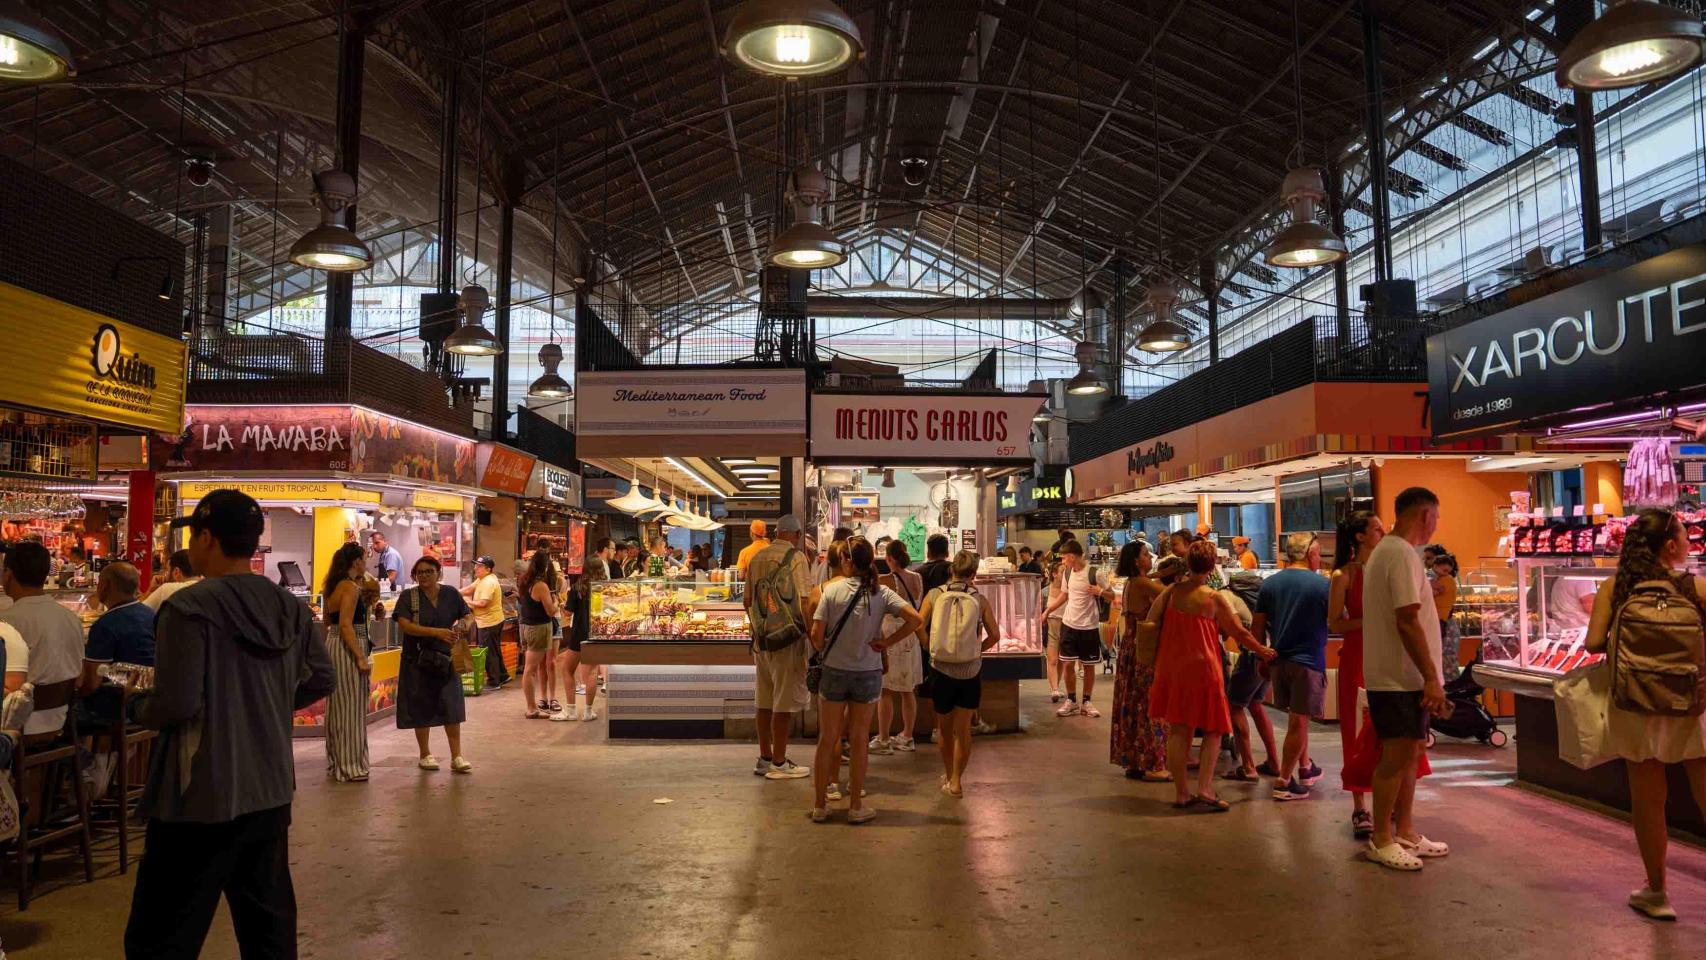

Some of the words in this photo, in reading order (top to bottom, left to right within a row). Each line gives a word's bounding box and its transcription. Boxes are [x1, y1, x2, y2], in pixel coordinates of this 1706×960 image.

[1451, 273, 1706, 392] XARCUTE
[613, 388, 725, 402] Mediterranean
[729, 388, 767, 402] Food
[1454, 403, 1484, 420] desde
[1485, 397, 1513, 415] 1989
[835, 408, 918, 441] MENUTS
[926, 409, 1008, 442] CARLOS
[202, 424, 235, 451] LA
[241, 424, 345, 452] MANABA
[997, 446, 1016, 455] 657
[329, 460, 347, 470] 605
[247, 484, 257, 492] EN
[259, 484, 285, 493] FRUITS
[287, 484, 327, 493] TROPICALS
